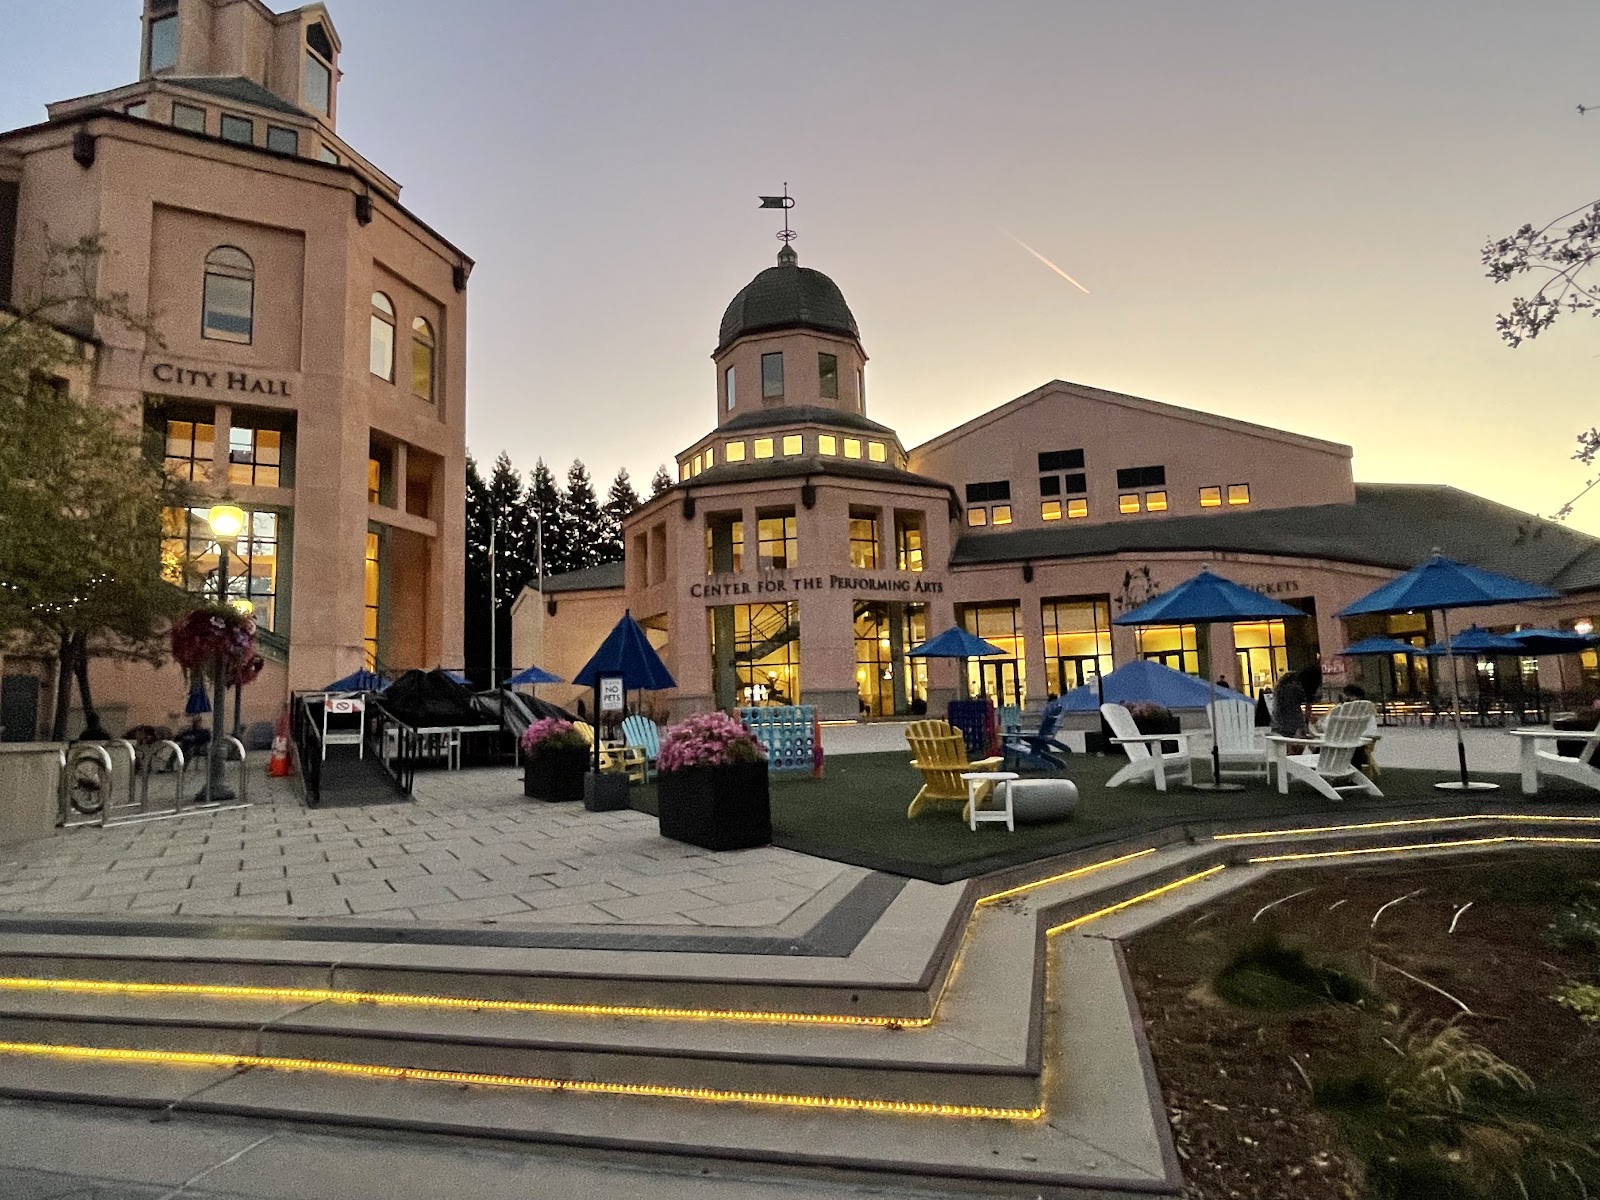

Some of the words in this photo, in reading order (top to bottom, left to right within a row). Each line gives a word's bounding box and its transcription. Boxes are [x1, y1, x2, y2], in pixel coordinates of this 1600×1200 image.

[152, 363, 217, 388] CITY
[226, 371, 292, 397] HALL
[690, 582, 752, 598] CENTER
[757, 580, 787, 593] FOR
[792, 577, 823, 591] THE
[829, 575, 910, 592] PERFORMING
[914, 579, 944, 593] ARTS
[605, 685, 619, 694] NO
[603, 694, 621, 702] PETS
